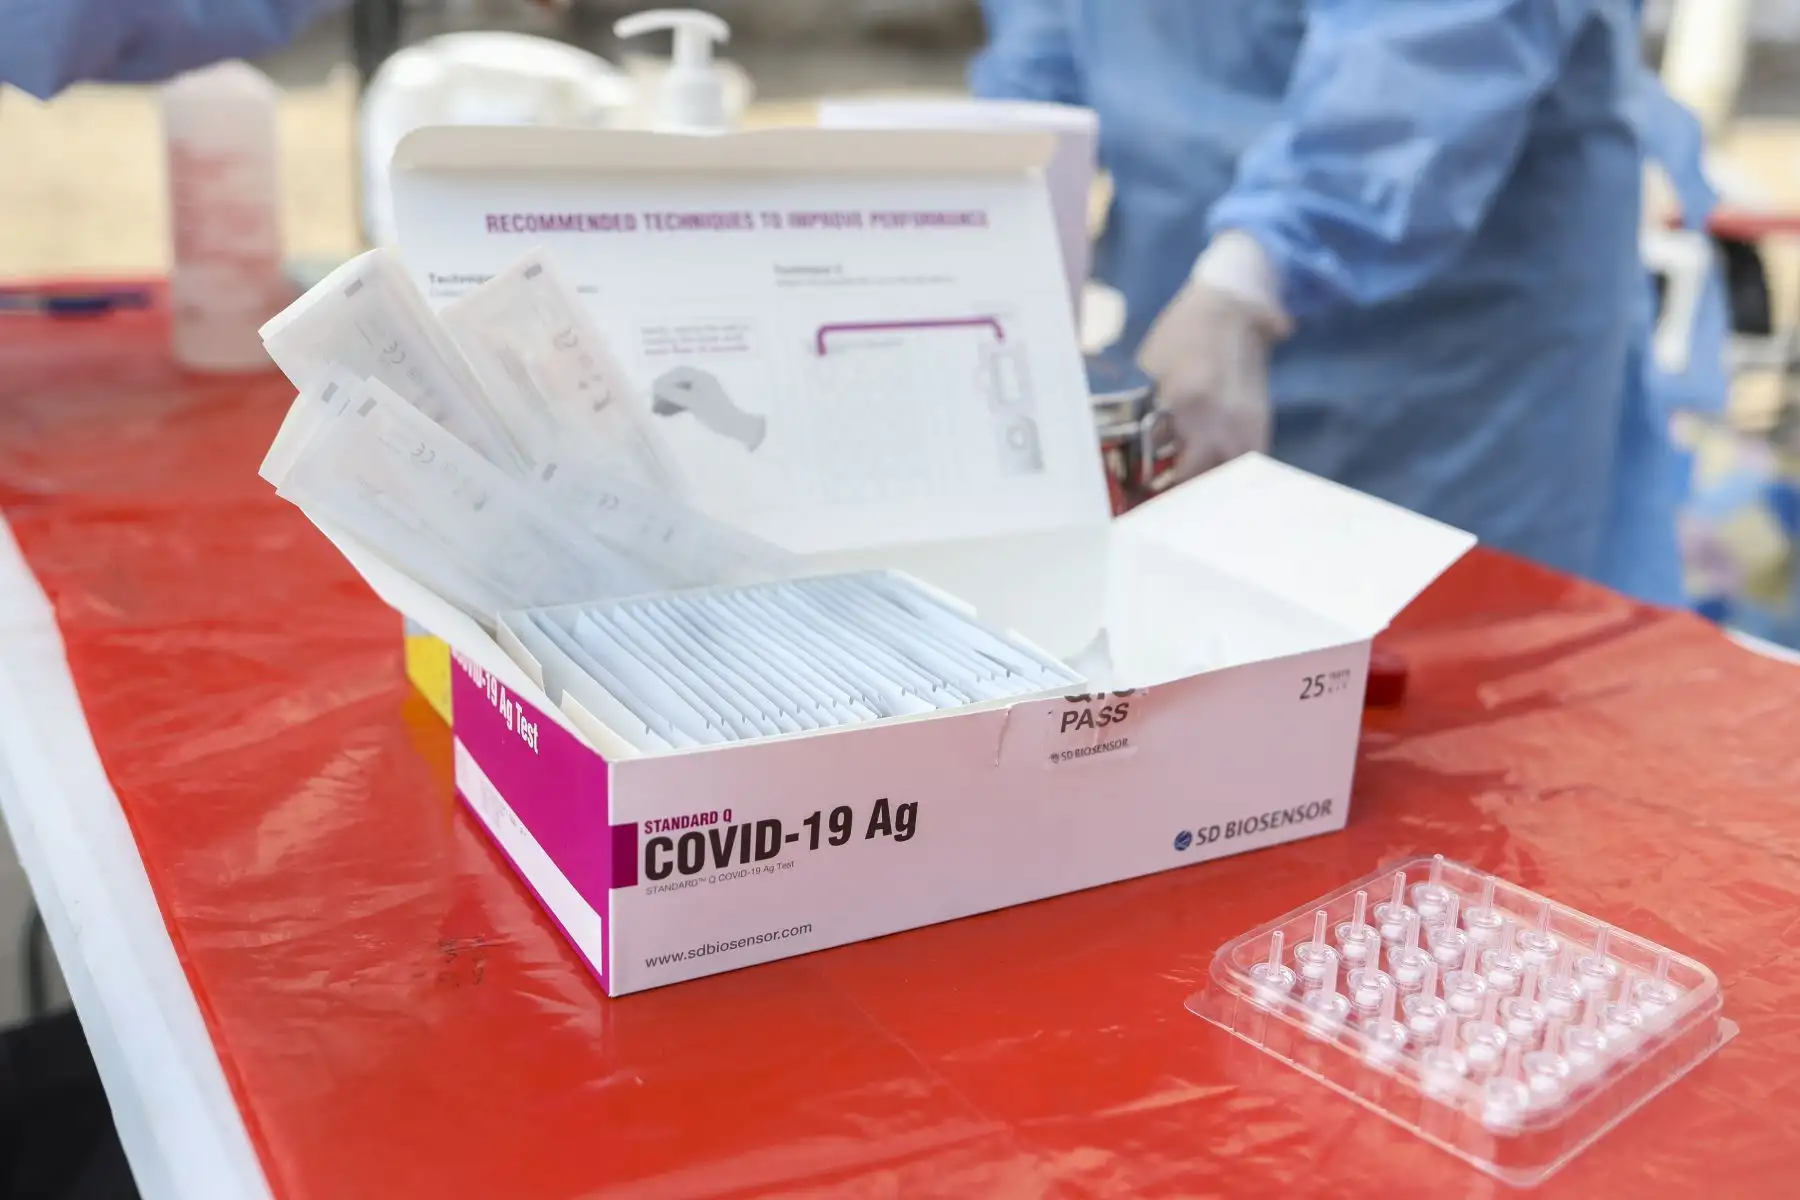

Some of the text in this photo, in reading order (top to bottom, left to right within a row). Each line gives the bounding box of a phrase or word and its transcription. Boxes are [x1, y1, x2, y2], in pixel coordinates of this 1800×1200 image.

[485, 212, 638, 234] RECOMMENDED
[643, 211, 755, 232] TECHNIQUES
[760, 211, 783, 230] TO
[1300, 674, 1325, 700] 25
[499, 685, 513, 731] Ag
[515, 701, 539, 755] Test
[1060, 702, 1129, 734] PASS
[1060, 738, 1128, 762] SD BIOSENSOR
[644, 808, 732, 835] STANDARD Q
[1196, 799, 1333, 846] SD BIOSENSOR
[644, 797, 918, 881] COVID-19 Ag
[708, 875, 717, 885] Q
[718, 866, 761, 883] COVID-19
[763, 864, 775, 875] Ag
[776, 860, 795, 871] Test
[645, 923, 812, 968] www.sdbiosensor.com
